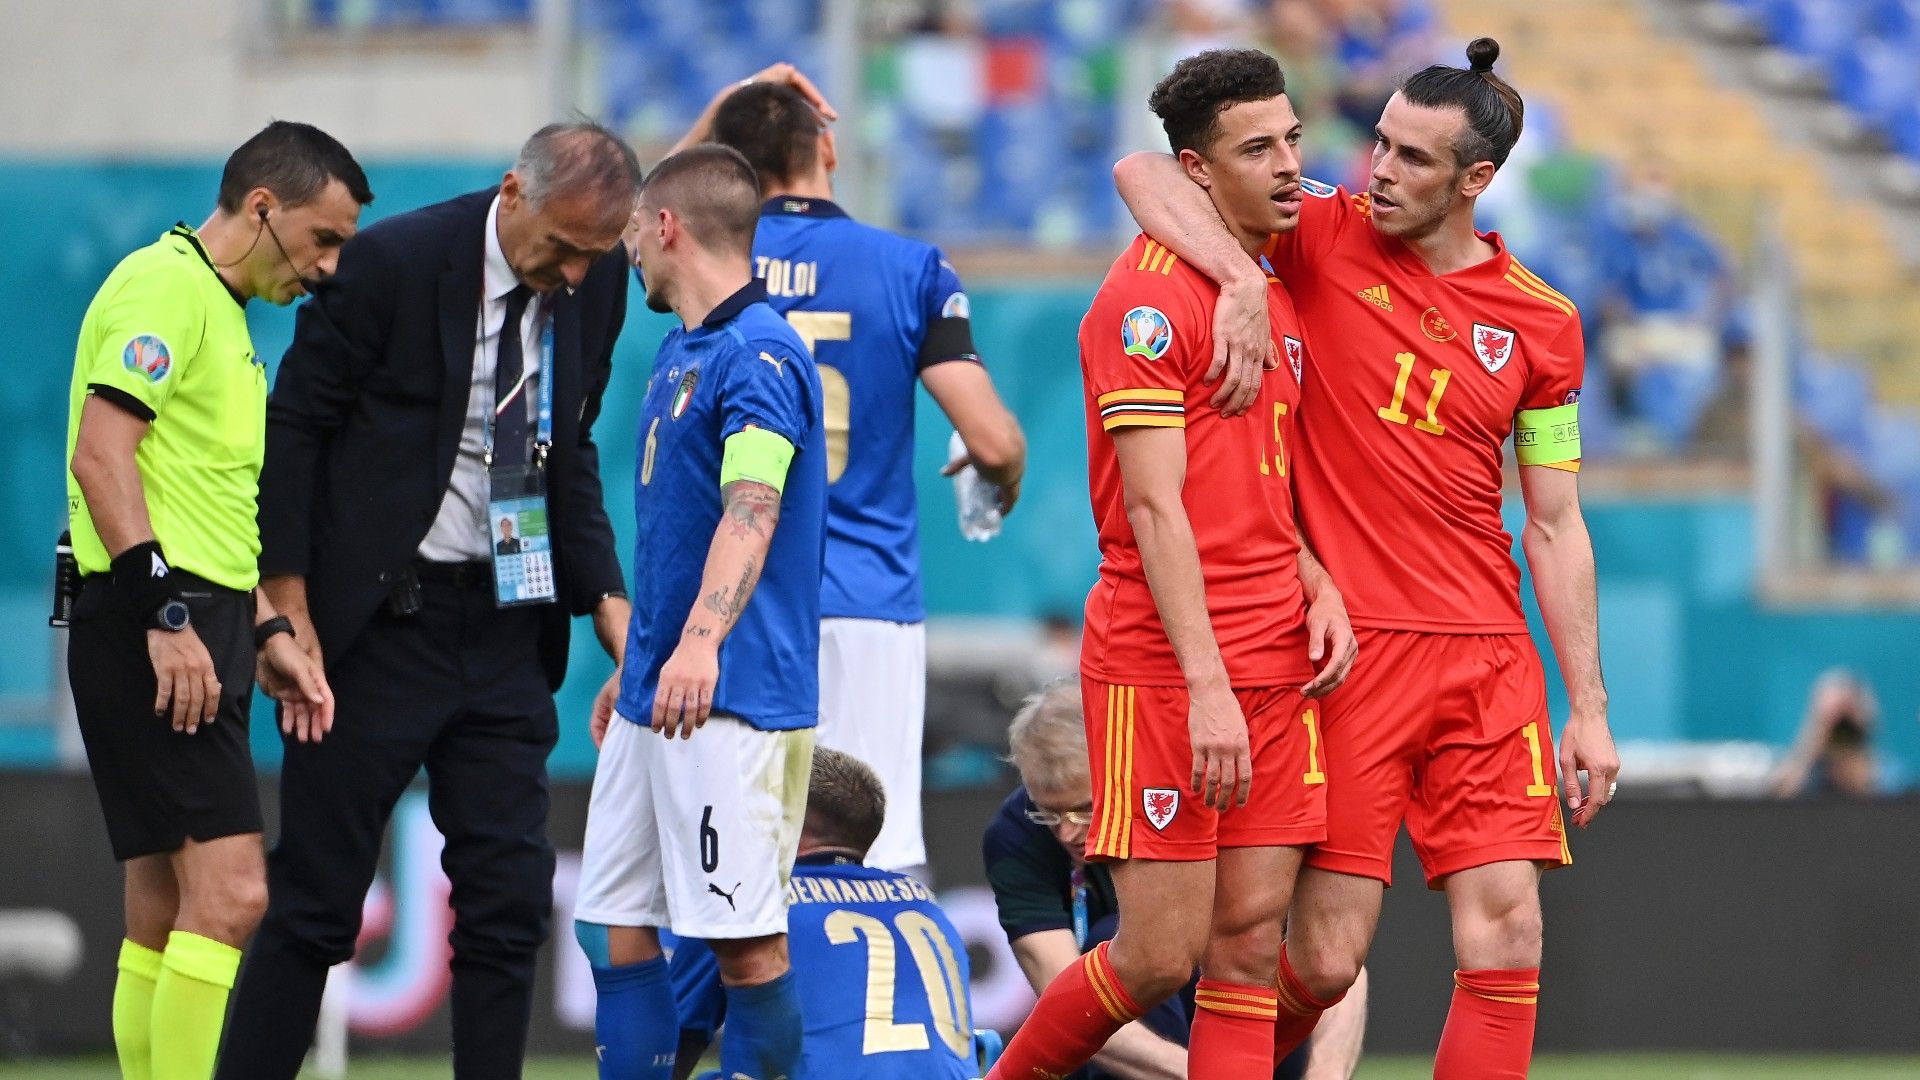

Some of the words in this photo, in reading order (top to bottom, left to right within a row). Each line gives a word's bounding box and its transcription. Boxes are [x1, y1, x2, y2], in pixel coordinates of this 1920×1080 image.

[755, 255, 818, 297] TOLOI
[1357, 291, 1394, 313] adidas
[1377, 351, 1452, 436] 11
[641, 416, 660, 486] 6
[1522, 721, 1558, 797] 1
[700, 805, 719, 874] 6
[823, 909, 971, 1060] 20
